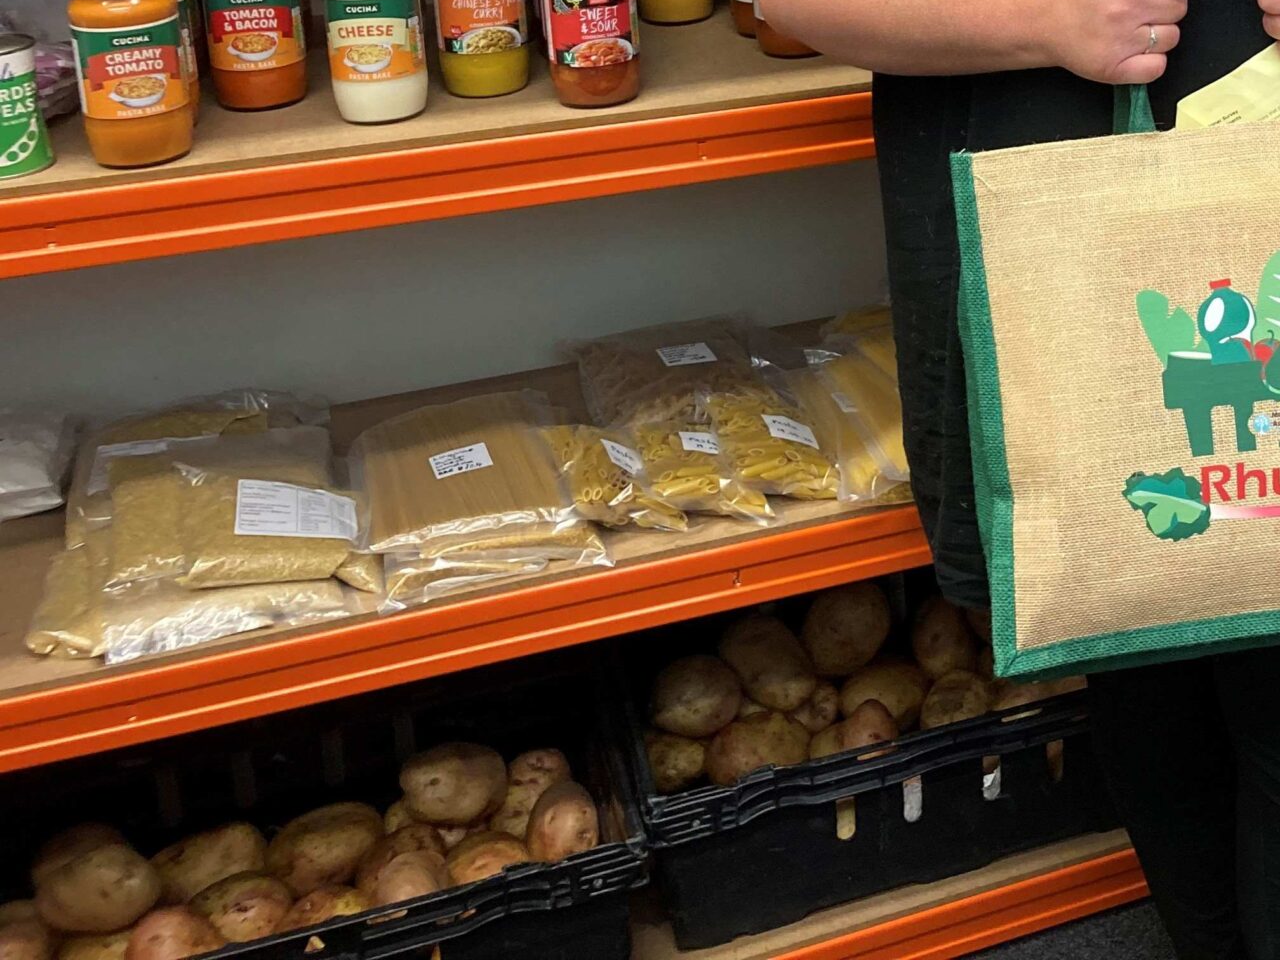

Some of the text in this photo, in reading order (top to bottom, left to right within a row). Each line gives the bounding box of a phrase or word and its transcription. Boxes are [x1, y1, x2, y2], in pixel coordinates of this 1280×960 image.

[223, 8, 275, 21] TOMATO
[345, 6, 378, 14] CUCINA
[473, 8, 503, 20] CURRY
[580, 5, 618, 21] SWEET
[224, 18, 278, 32] & BACON
[337, 25, 394, 39] CHEESE
[590, 18, 620, 34] SOUR
[112, 35, 150, 46] CUCINA
[105, 47, 162, 65] CREAMY
[105, 59, 164, 76] TOMATO
[0, 98, 35, 117] EAS
